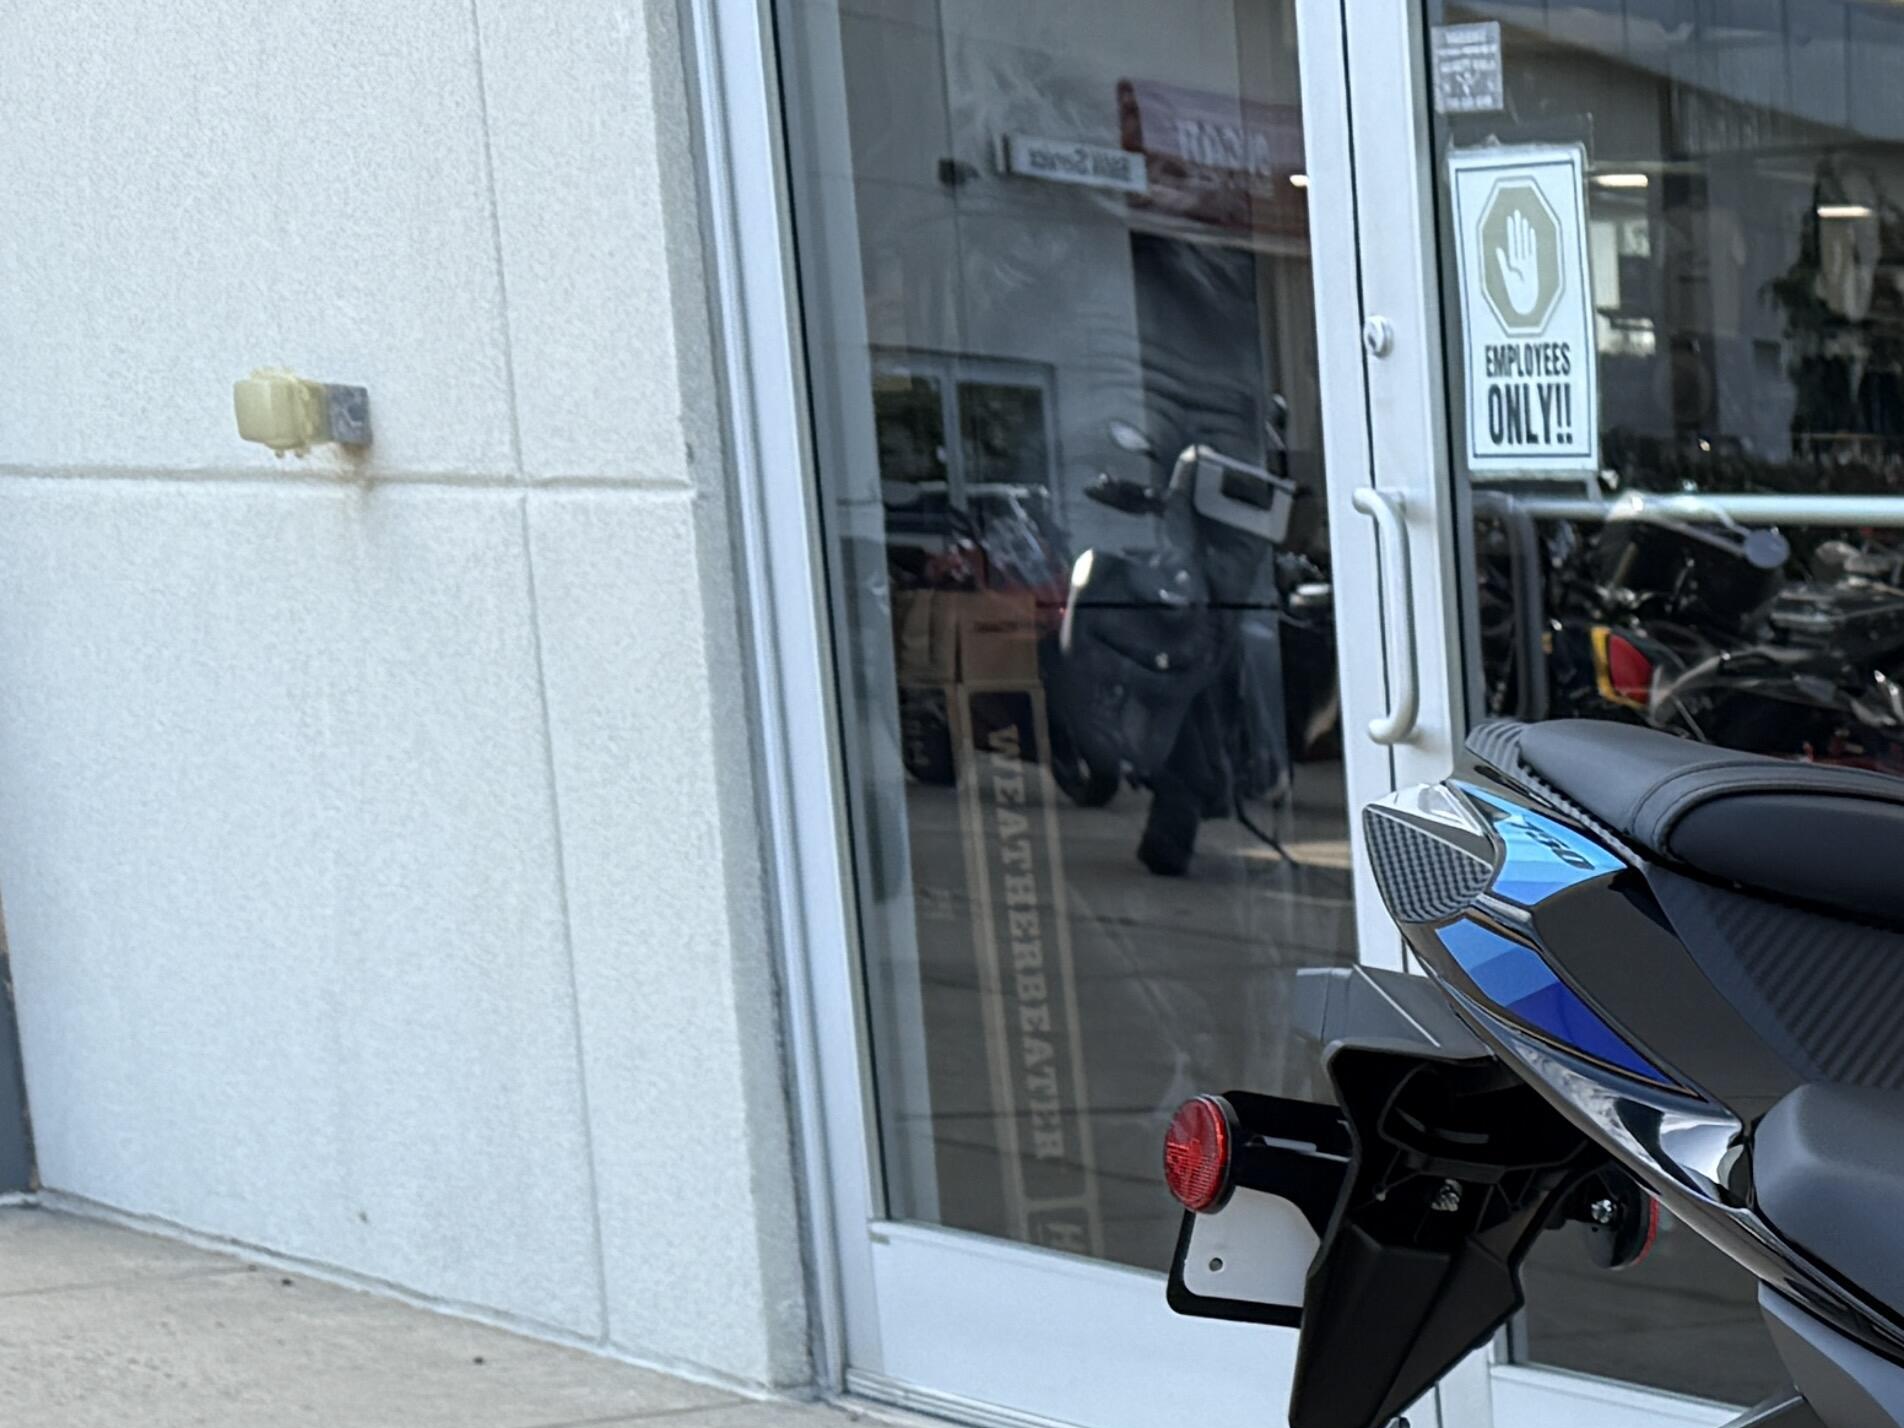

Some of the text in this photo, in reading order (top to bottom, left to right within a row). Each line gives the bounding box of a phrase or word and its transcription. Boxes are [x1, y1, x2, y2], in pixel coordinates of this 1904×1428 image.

[1484, 342, 1571, 378] EMPLOYEES
[1488, 382, 1573, 445] ONLY!!
[985, 724, 1064, 1157] WEATHERBEATER
